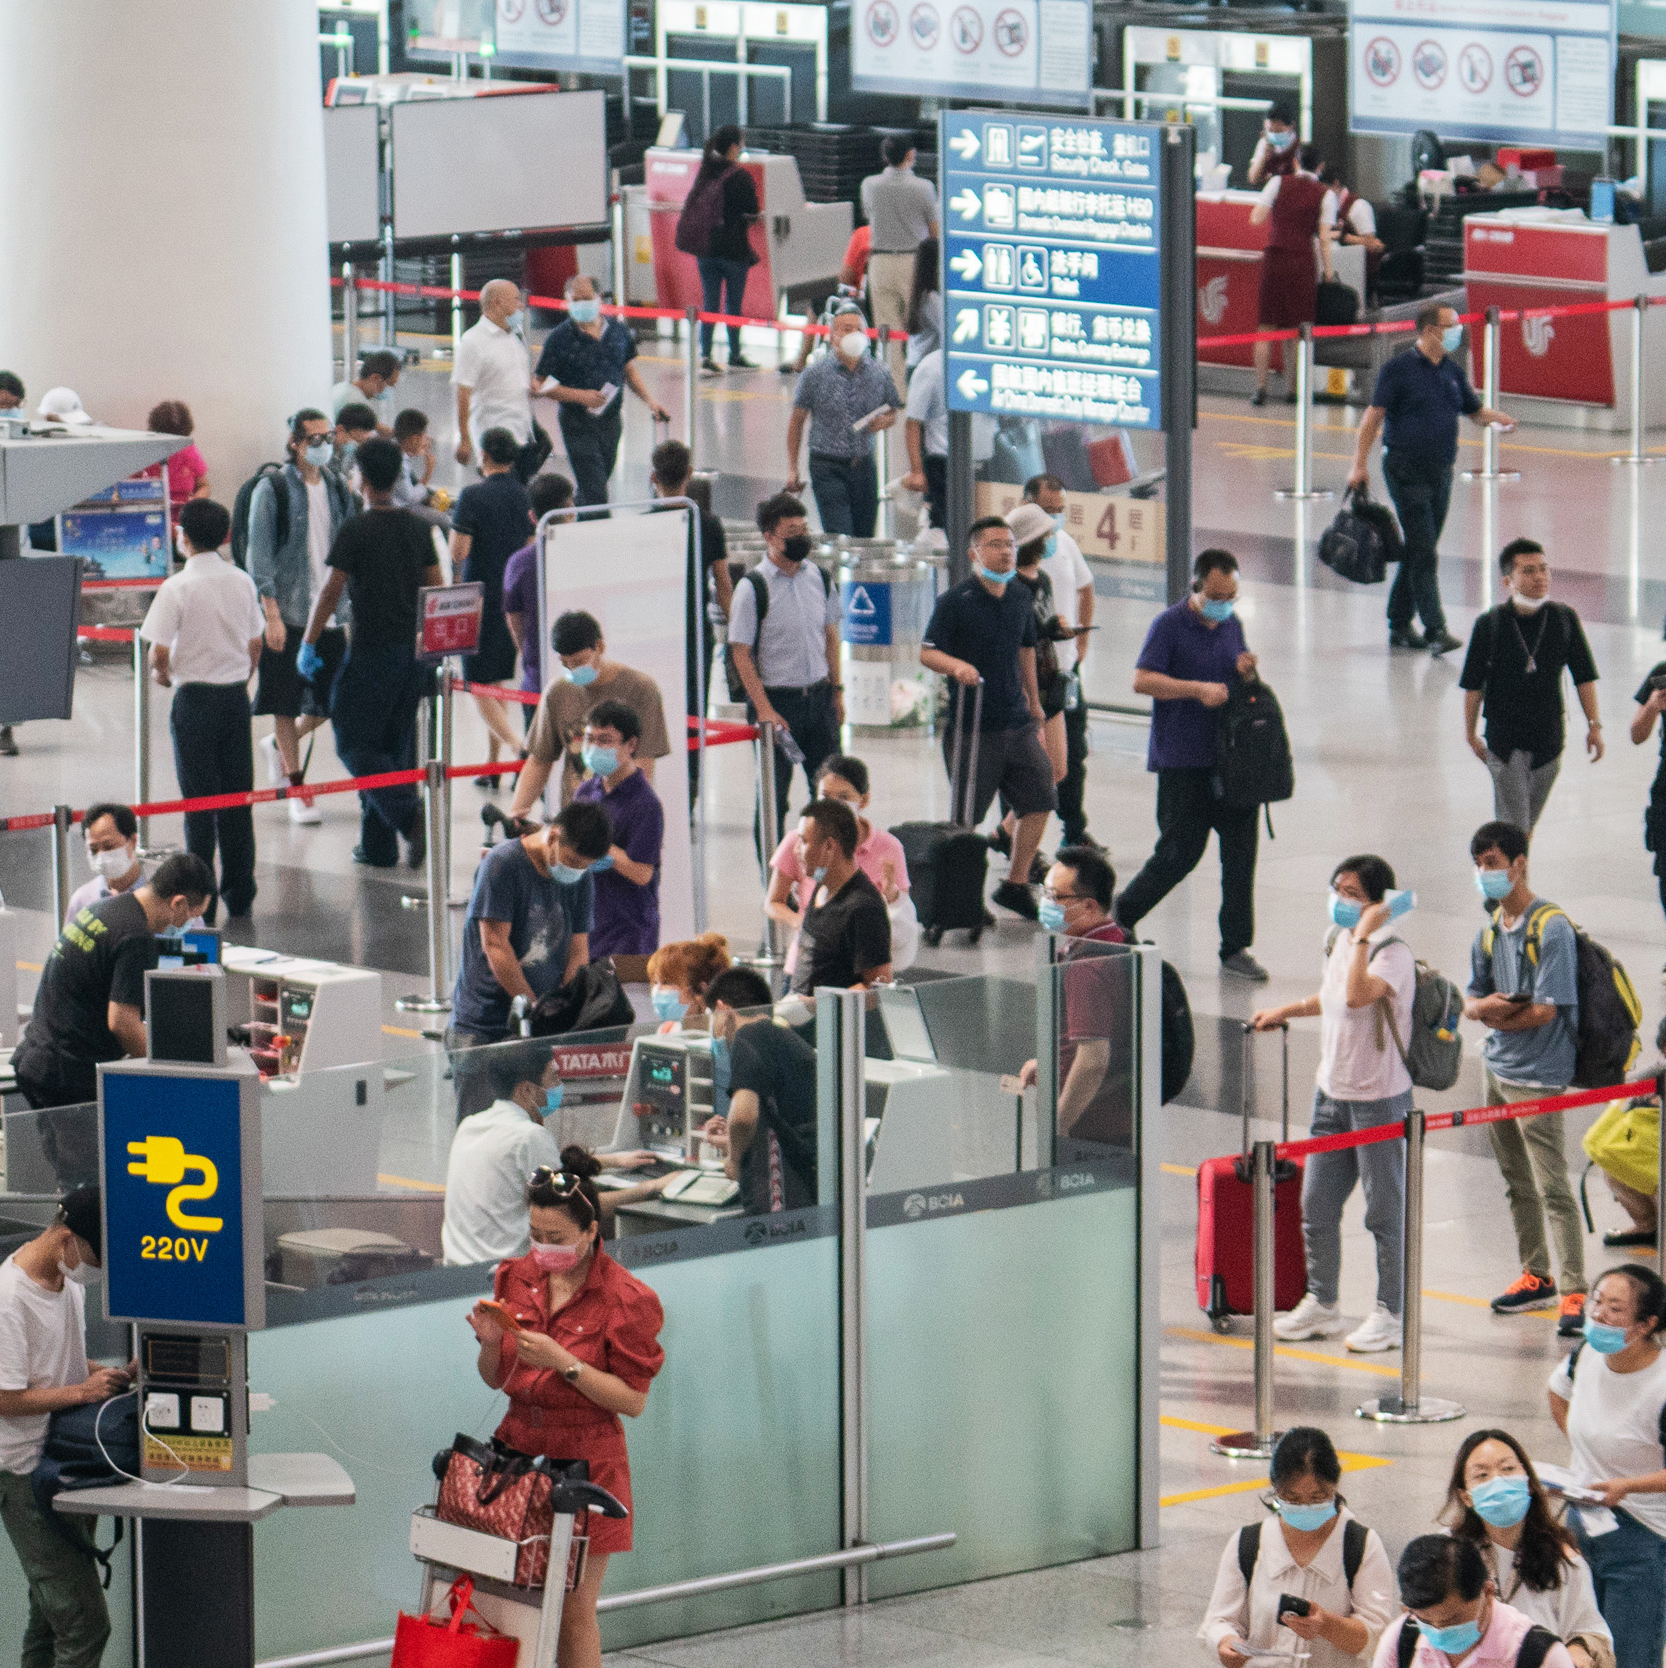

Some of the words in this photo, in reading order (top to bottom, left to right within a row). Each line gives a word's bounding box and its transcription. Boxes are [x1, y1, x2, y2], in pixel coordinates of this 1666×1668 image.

[1050, 249, 1100, 281] 洗手间
[928, 1192, 965, 1212] BCIA
[141, 1235, 209, 1262] 220V
